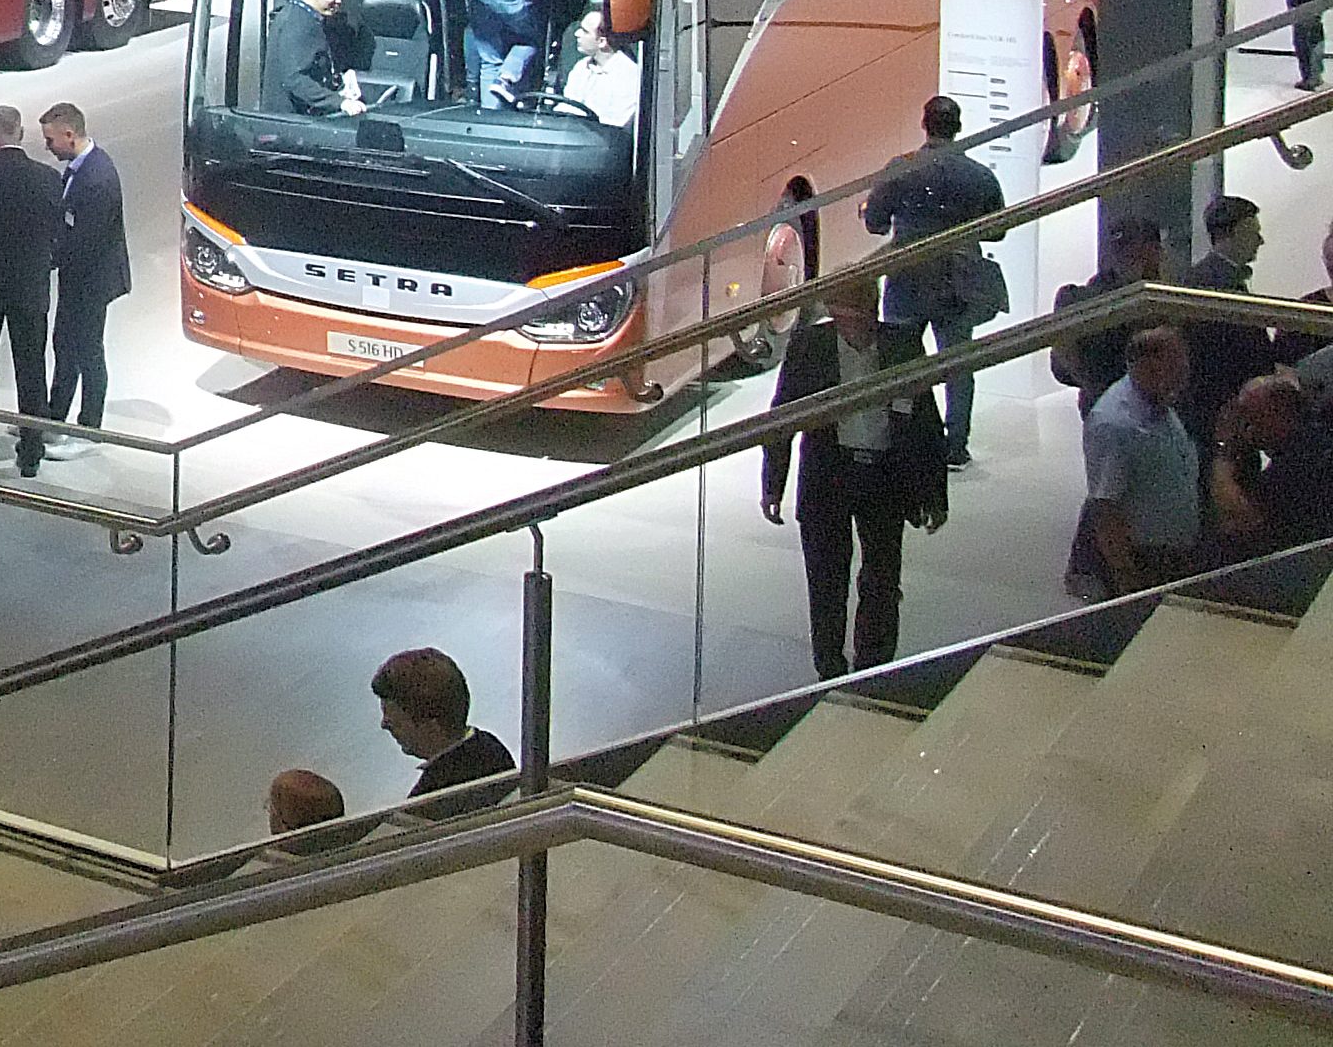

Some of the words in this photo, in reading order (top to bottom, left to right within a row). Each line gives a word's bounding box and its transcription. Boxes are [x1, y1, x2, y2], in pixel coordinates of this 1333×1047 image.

[304, 263, 453, 297] SETRA
[348, 339, 357, 353] S
[359, 340, 380, 356] 516
[383, 344, 404, 359] HD
